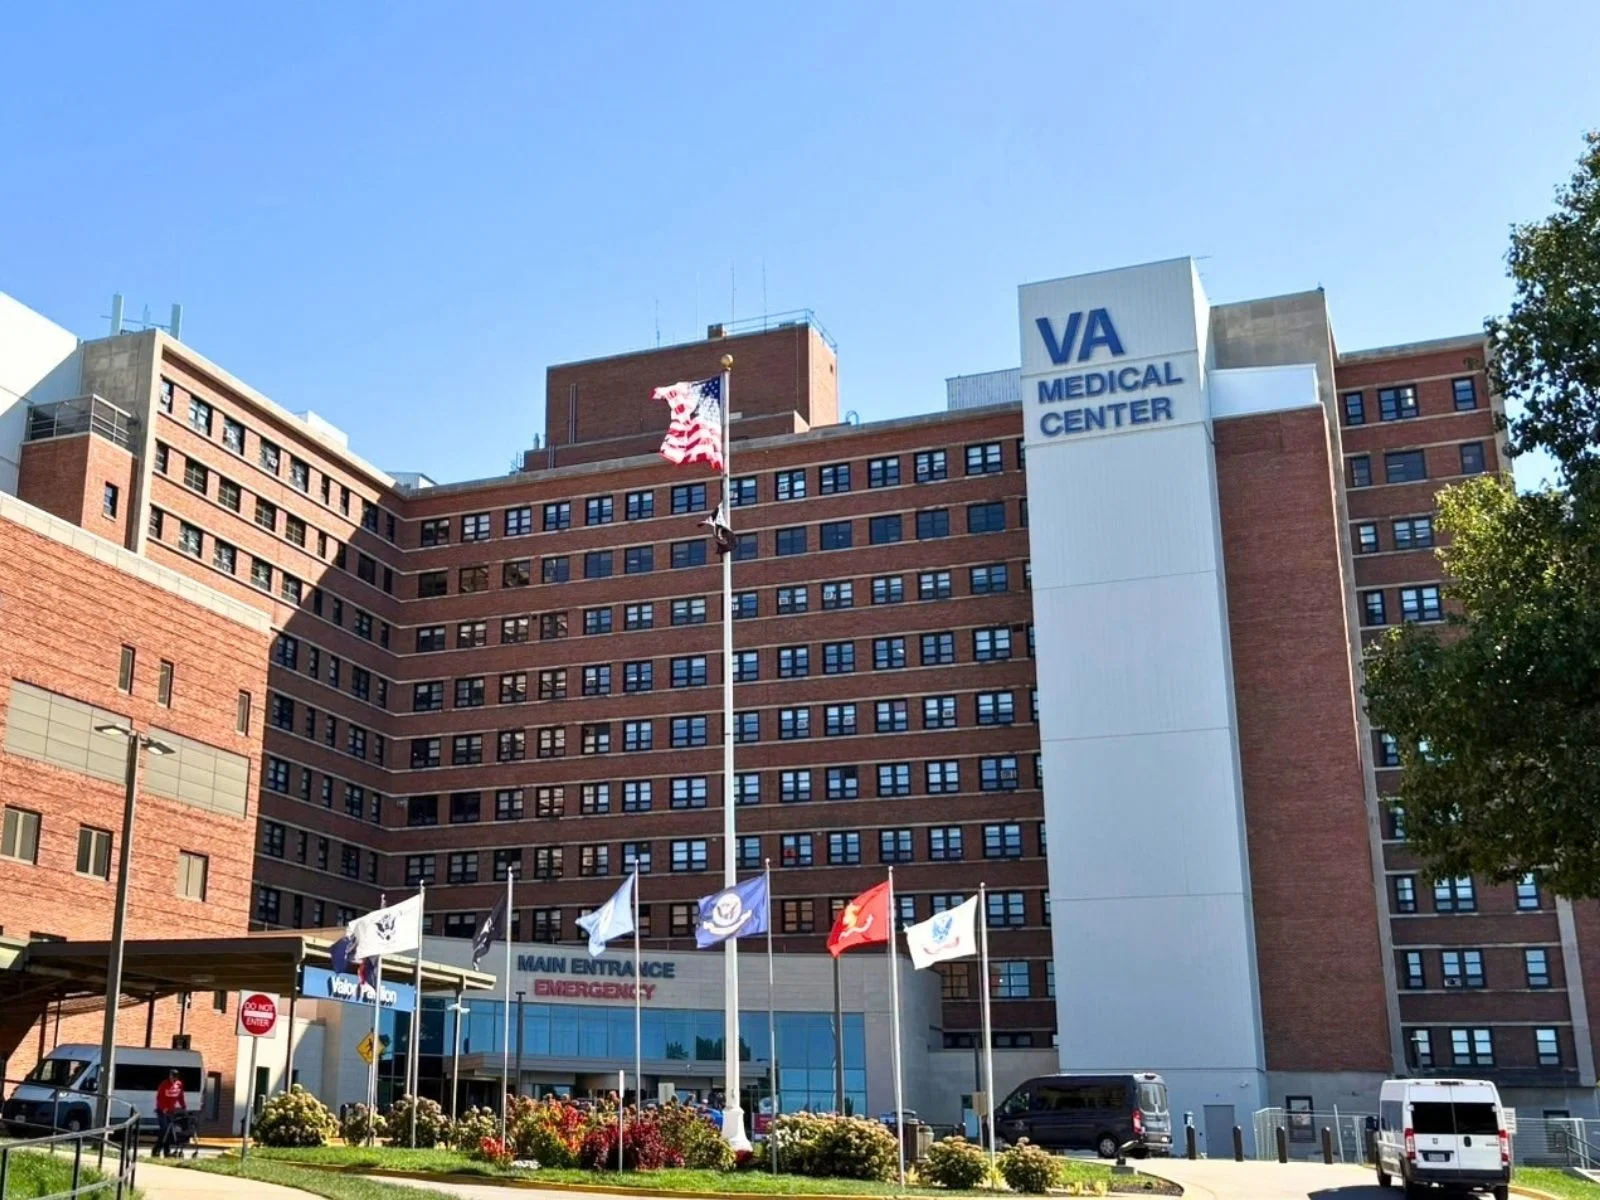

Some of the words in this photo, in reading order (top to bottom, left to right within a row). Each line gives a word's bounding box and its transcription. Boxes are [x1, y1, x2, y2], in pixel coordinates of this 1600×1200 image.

[1035, 307, 1125, 365] VA
[1037, 361, 1184, 404] MEDICAL
[1039, 396, 1173, 437] CENTER
[518, 955, 566, 973] MAIN
[571, 958, 675, 979] ENTRANCE
[331, 974, 357, 996] Valor
[534, 979, 657, 1001] EMERGENCY
[244, 1001, 257, 1010] DO
[258, 1003, 273, 1011] NOT
[245, 1017, 270, 1027] ENTER
